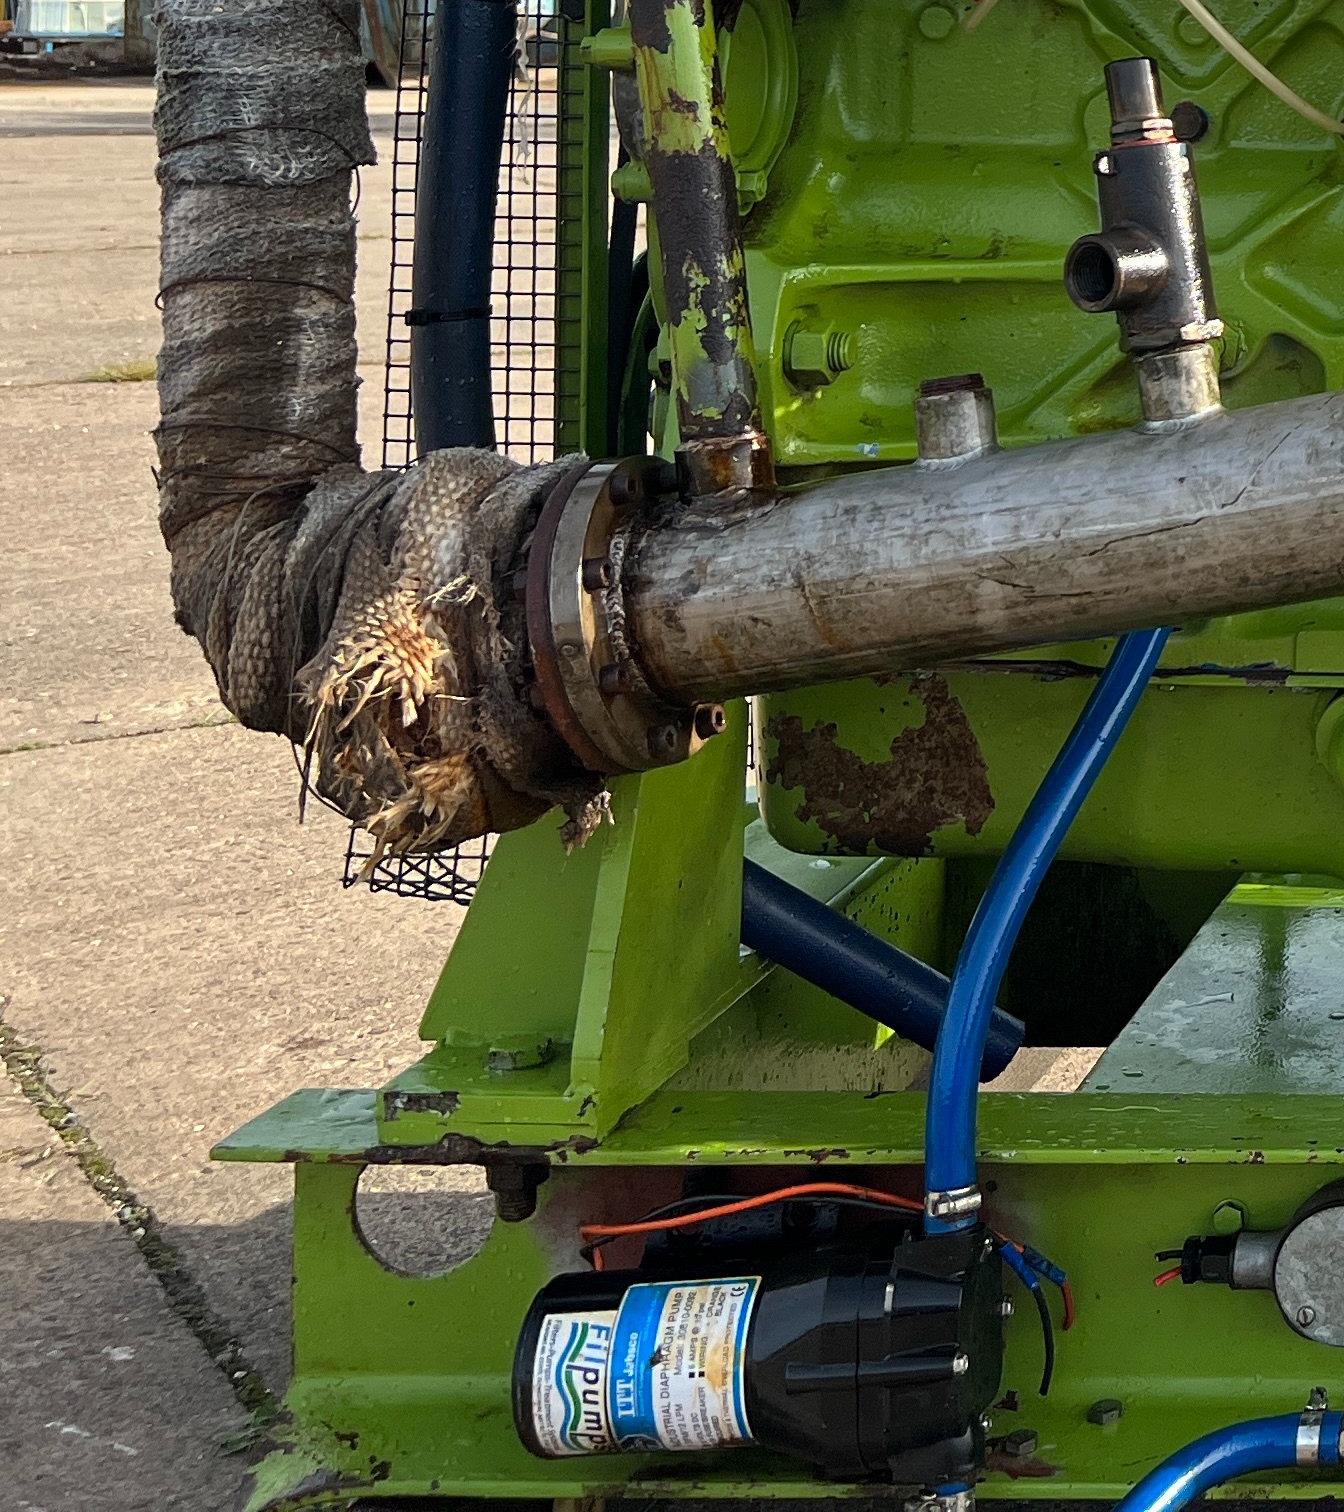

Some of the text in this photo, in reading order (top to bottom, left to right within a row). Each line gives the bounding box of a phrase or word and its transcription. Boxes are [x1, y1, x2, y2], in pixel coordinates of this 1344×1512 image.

[729, 1286, 746, 1297] CE
[667, 1292, 683, 1322] PUMP
[715, 1292, 726, 1317] BLACK
[616, 1332, 638, 1418] ITT Jabsco
[675, 1404, 685, 1421] LPM
